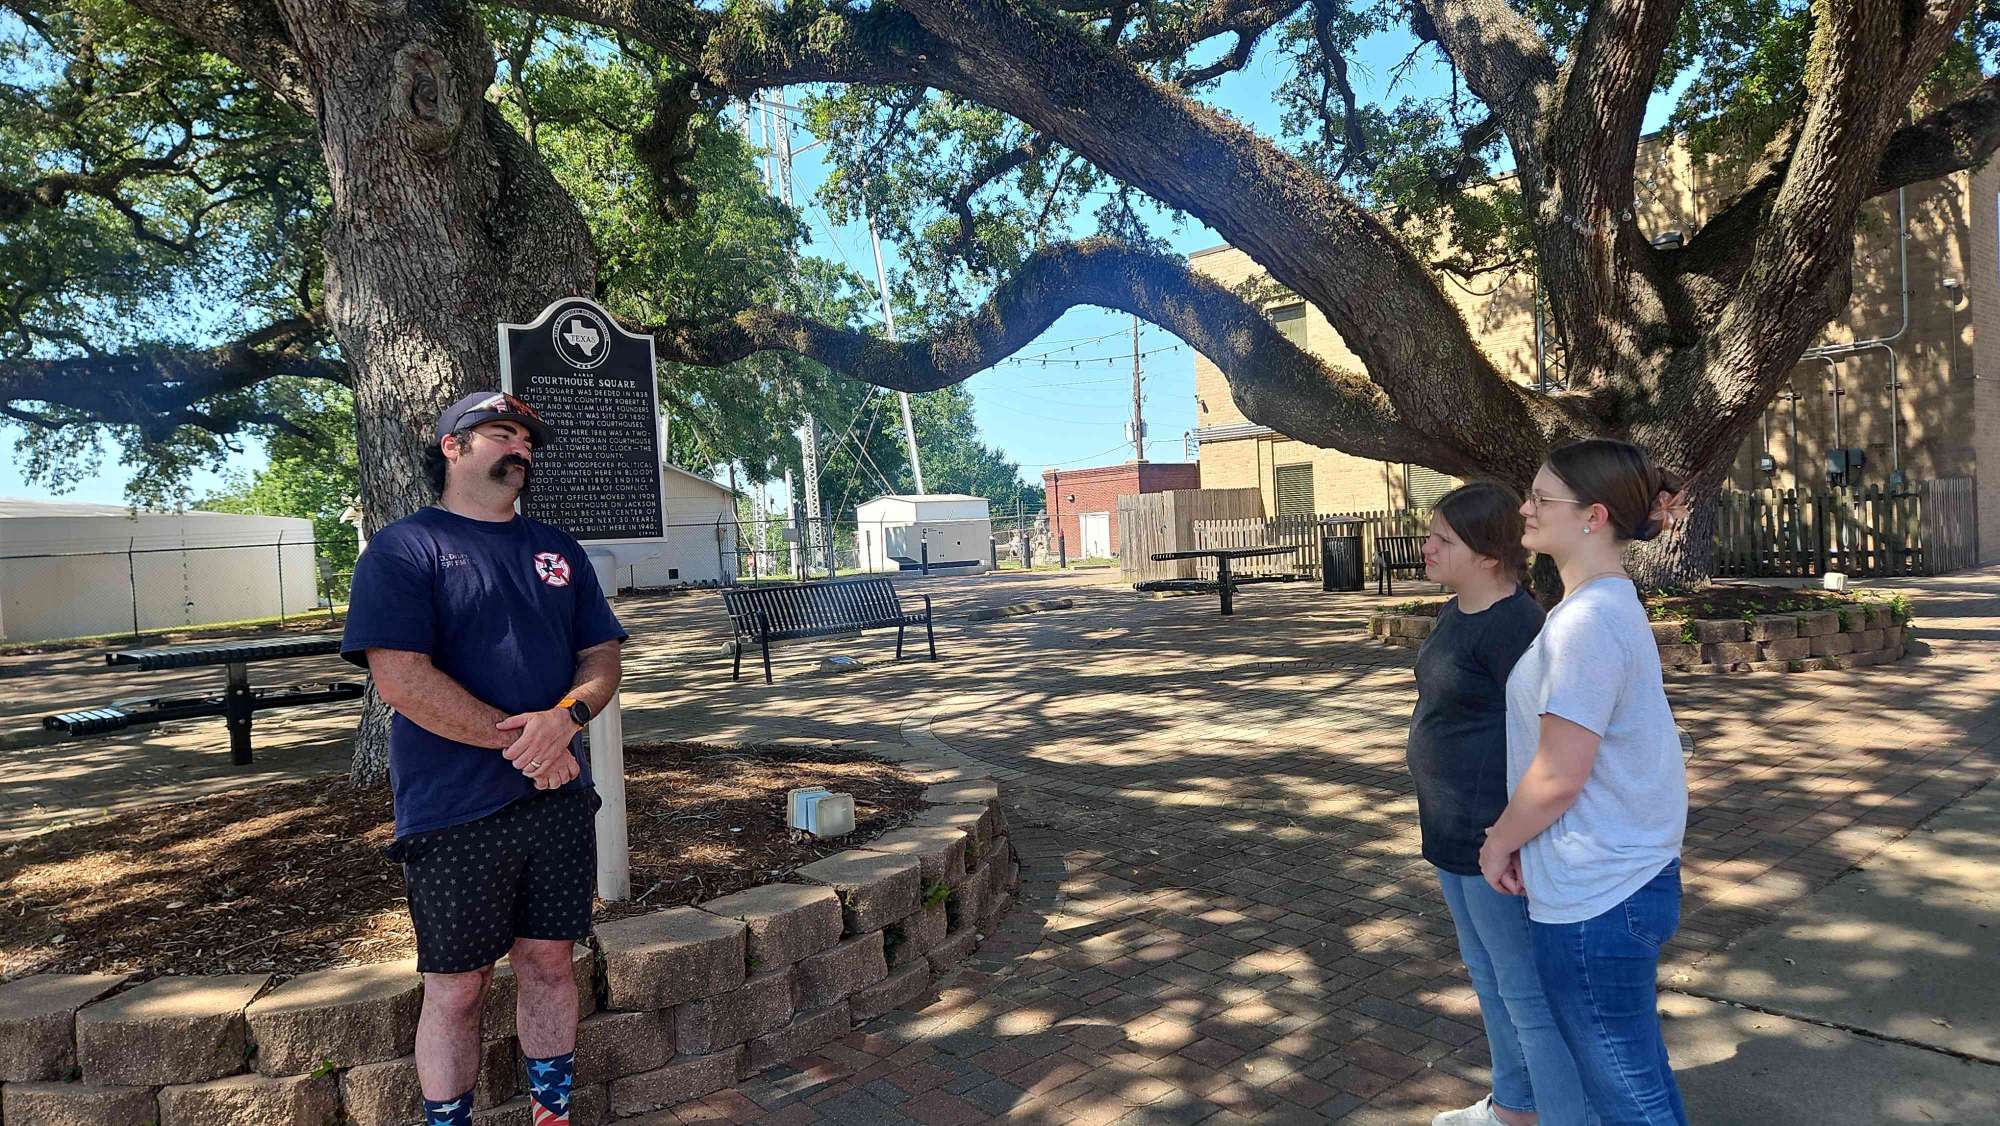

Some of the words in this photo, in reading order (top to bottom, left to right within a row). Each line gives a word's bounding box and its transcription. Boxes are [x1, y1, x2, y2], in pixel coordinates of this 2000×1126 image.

[571, 335, 596, 343] TEXAS
[531, 376, 594, 386] COURTHOUSE
[599, 379, 636, 388] SQUARE
[546, 387, 574, 395] SQUARE
[609, 437, 651, 445] COURTHOUSE
